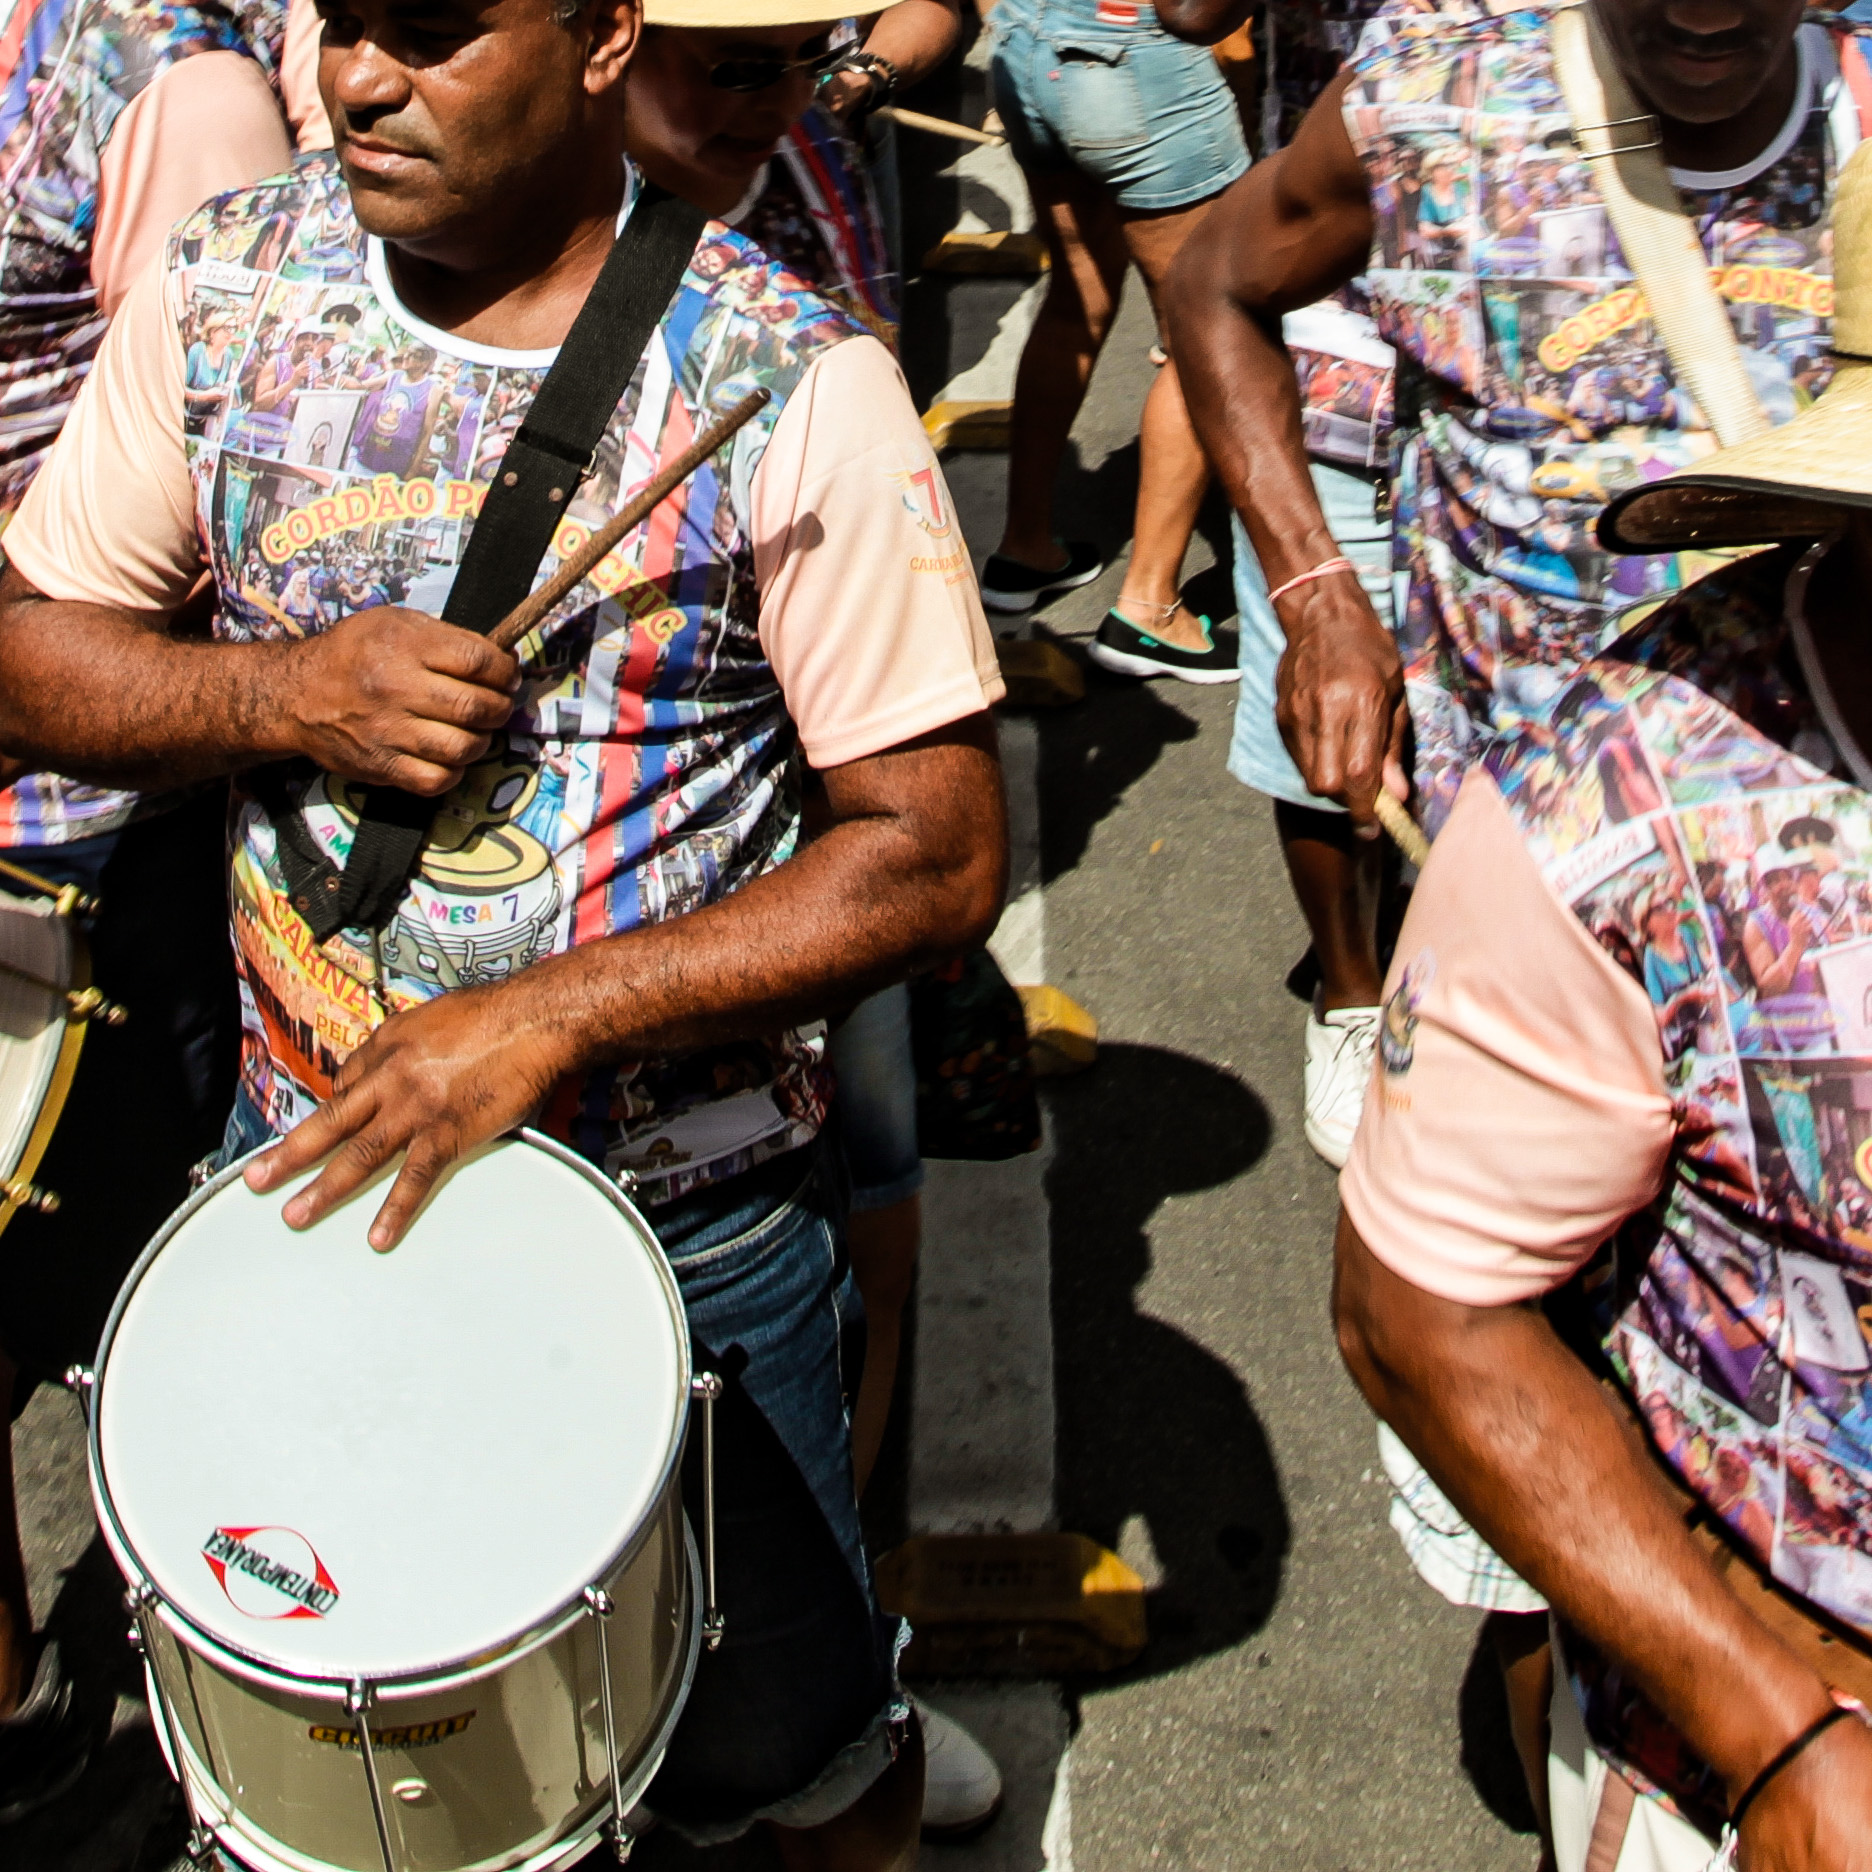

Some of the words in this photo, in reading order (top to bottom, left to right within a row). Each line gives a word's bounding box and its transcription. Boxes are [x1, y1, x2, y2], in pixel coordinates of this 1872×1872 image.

[263, 475, 436, 561] CORDÃO
[594, 555, 685, 641] CHIC
[429, 901, 493, 925] MESA
[502, 894, 521, 923] 7
